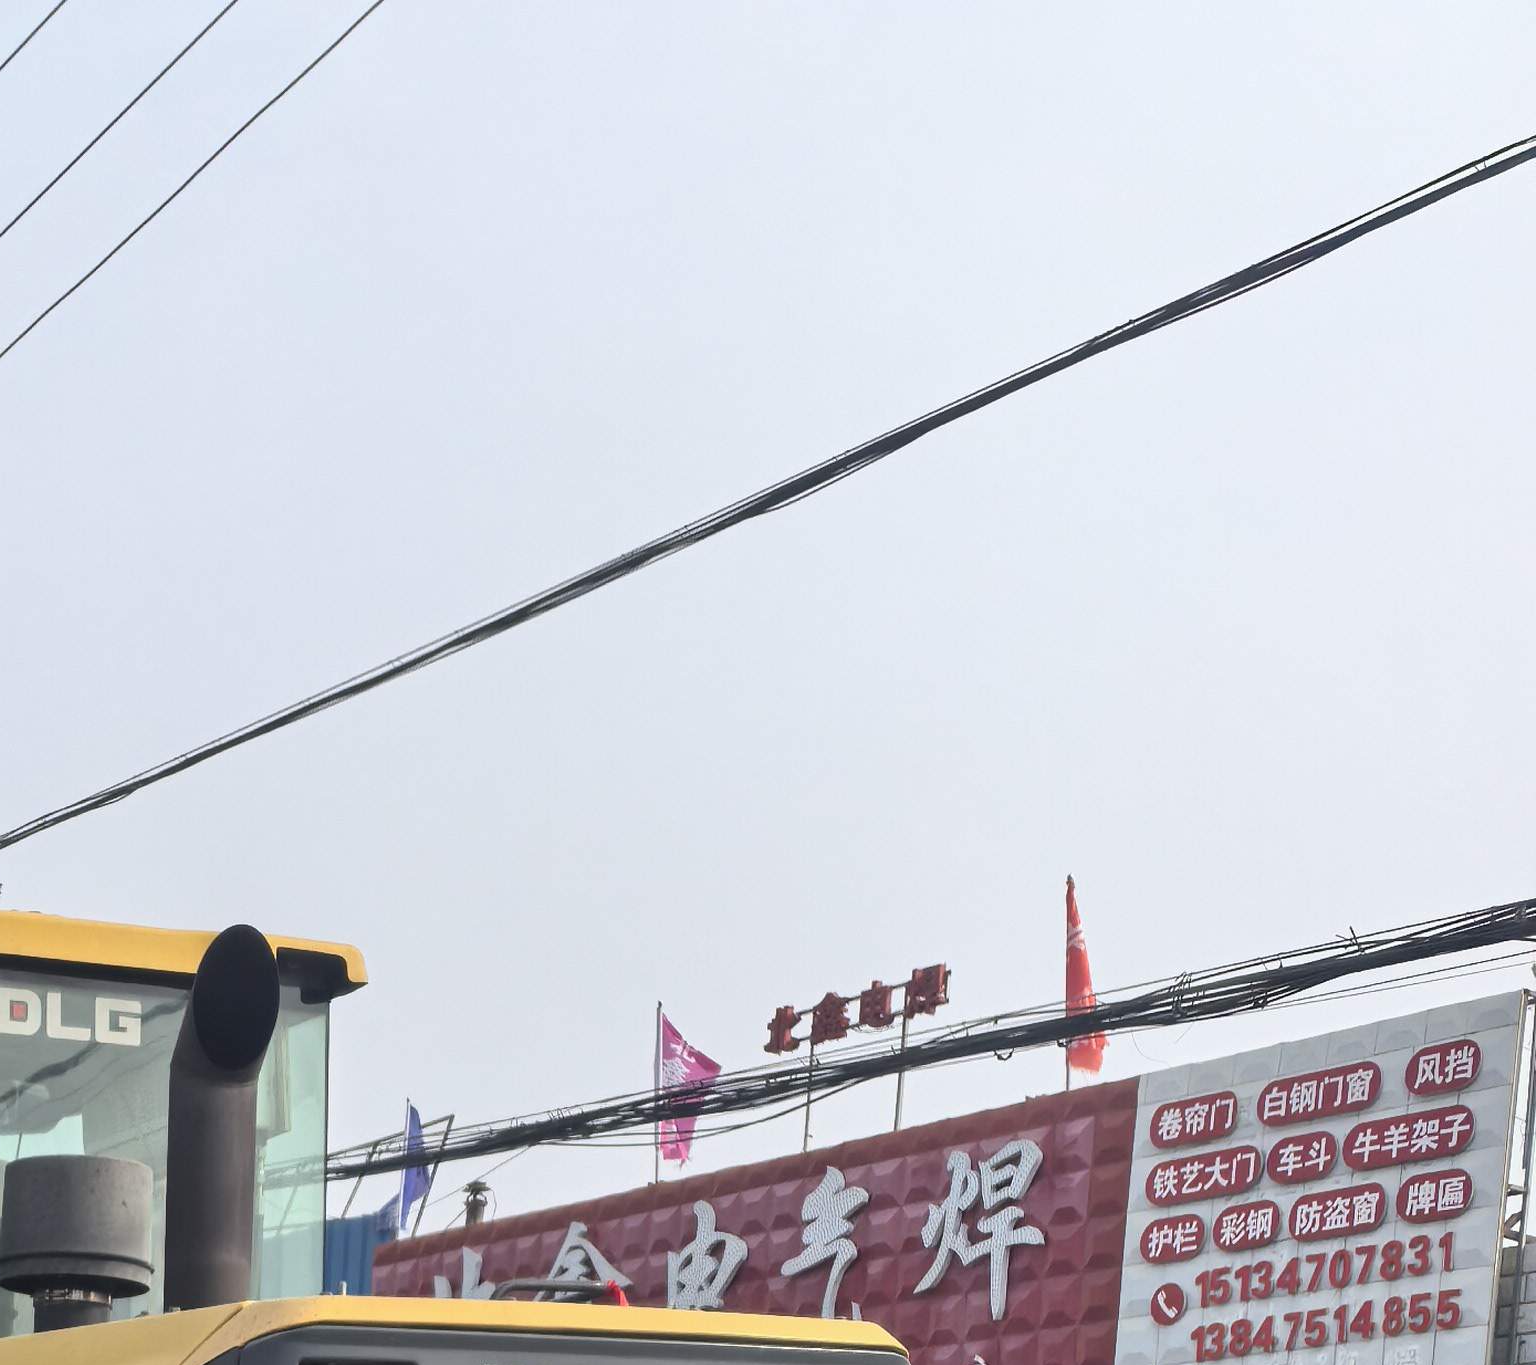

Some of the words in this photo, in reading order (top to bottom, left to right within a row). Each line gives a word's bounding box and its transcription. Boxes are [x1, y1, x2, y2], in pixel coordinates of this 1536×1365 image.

[1158, 1098, 1236, 1142] 卷帘门
[1263, 1068, 1375, 1122] 白钢门窗
[1414, 1044, 1476, 1089] 风挡
[1153, 1152, 1262, 1200] 铁艺大门
[1277, 1137, 1332, 1177] 车斗
[1352, 1112, 1472, 1163] 牛羊架子
[1148, 1221, 1199, 1259] 护栏
[1219, 1207, 1274, 1246] 彩钢
[1295, 1191, 1381, 1236] 防盗窗
[1406, 1175, 1468, 1217] 牌匾
[1195, 1231, 1456, 1308] 15134707831
[1190, 1289, 1463, 1363] 13847514855
